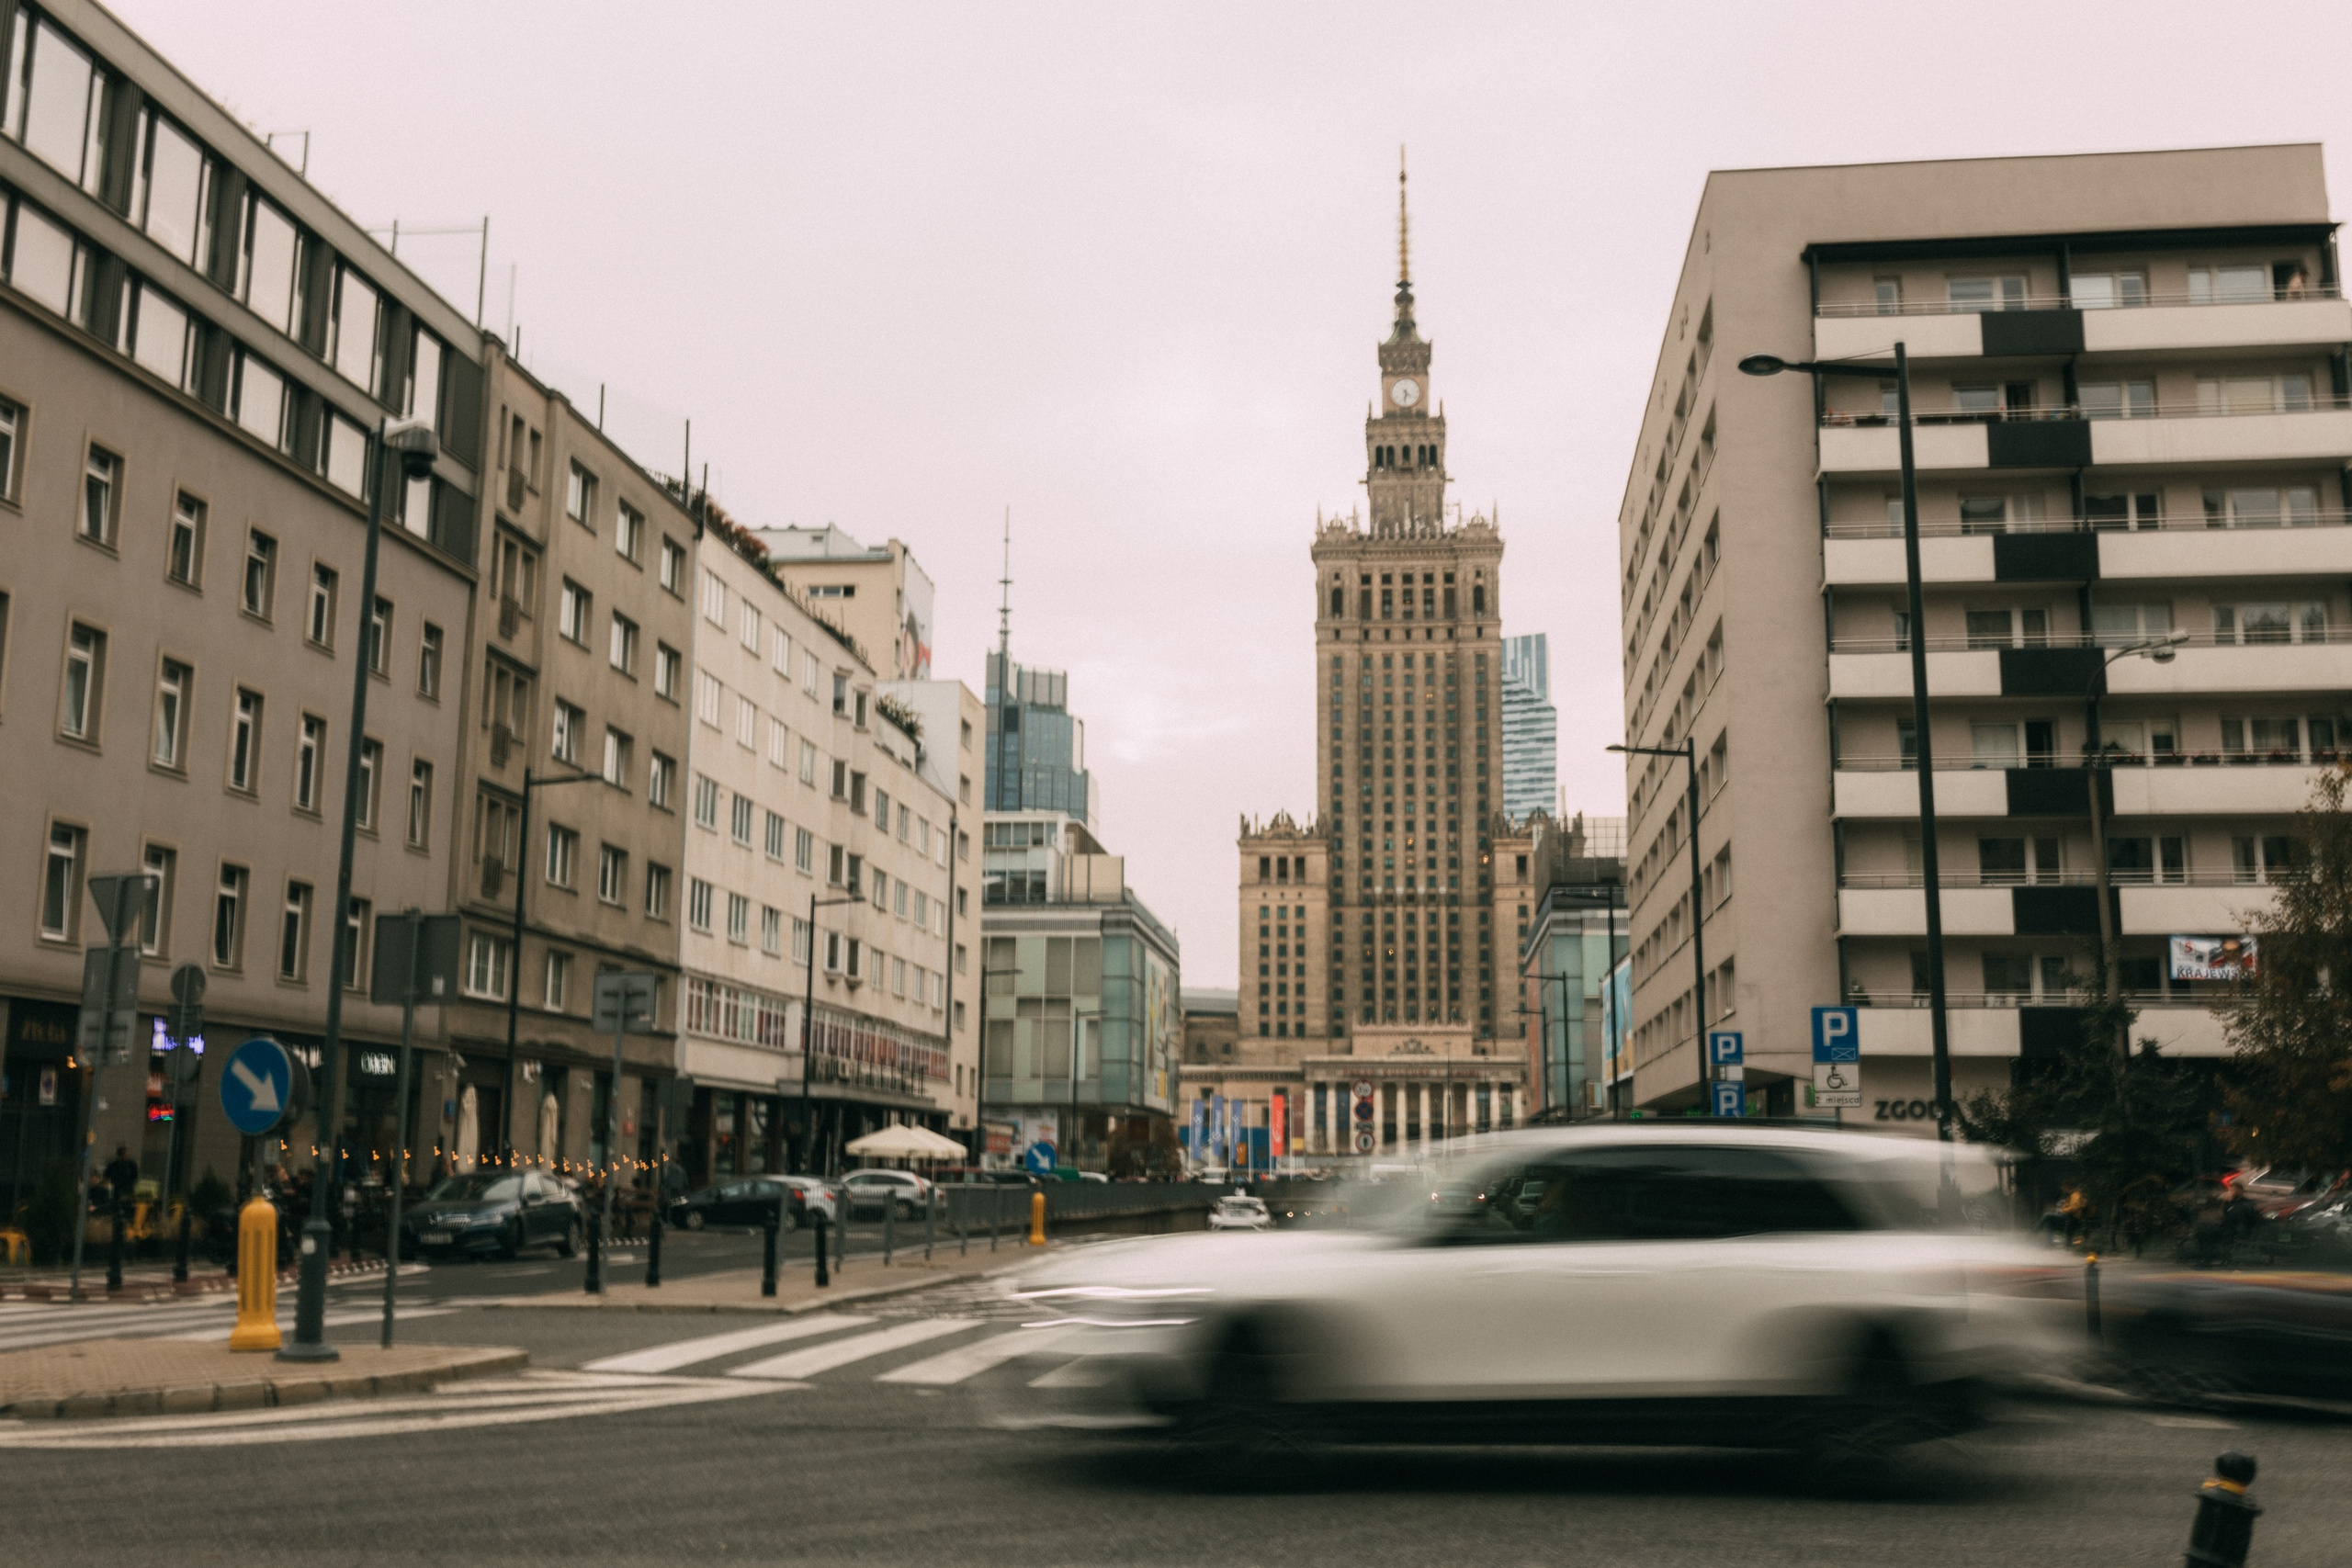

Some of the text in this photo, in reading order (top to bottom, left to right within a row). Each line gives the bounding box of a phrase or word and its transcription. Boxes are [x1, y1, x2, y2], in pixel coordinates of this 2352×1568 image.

[1822, 1012, 1849, 1046] P
[1717, 1035, 1736, 1061] P
[1719, 1090, 1738, 1116] P
